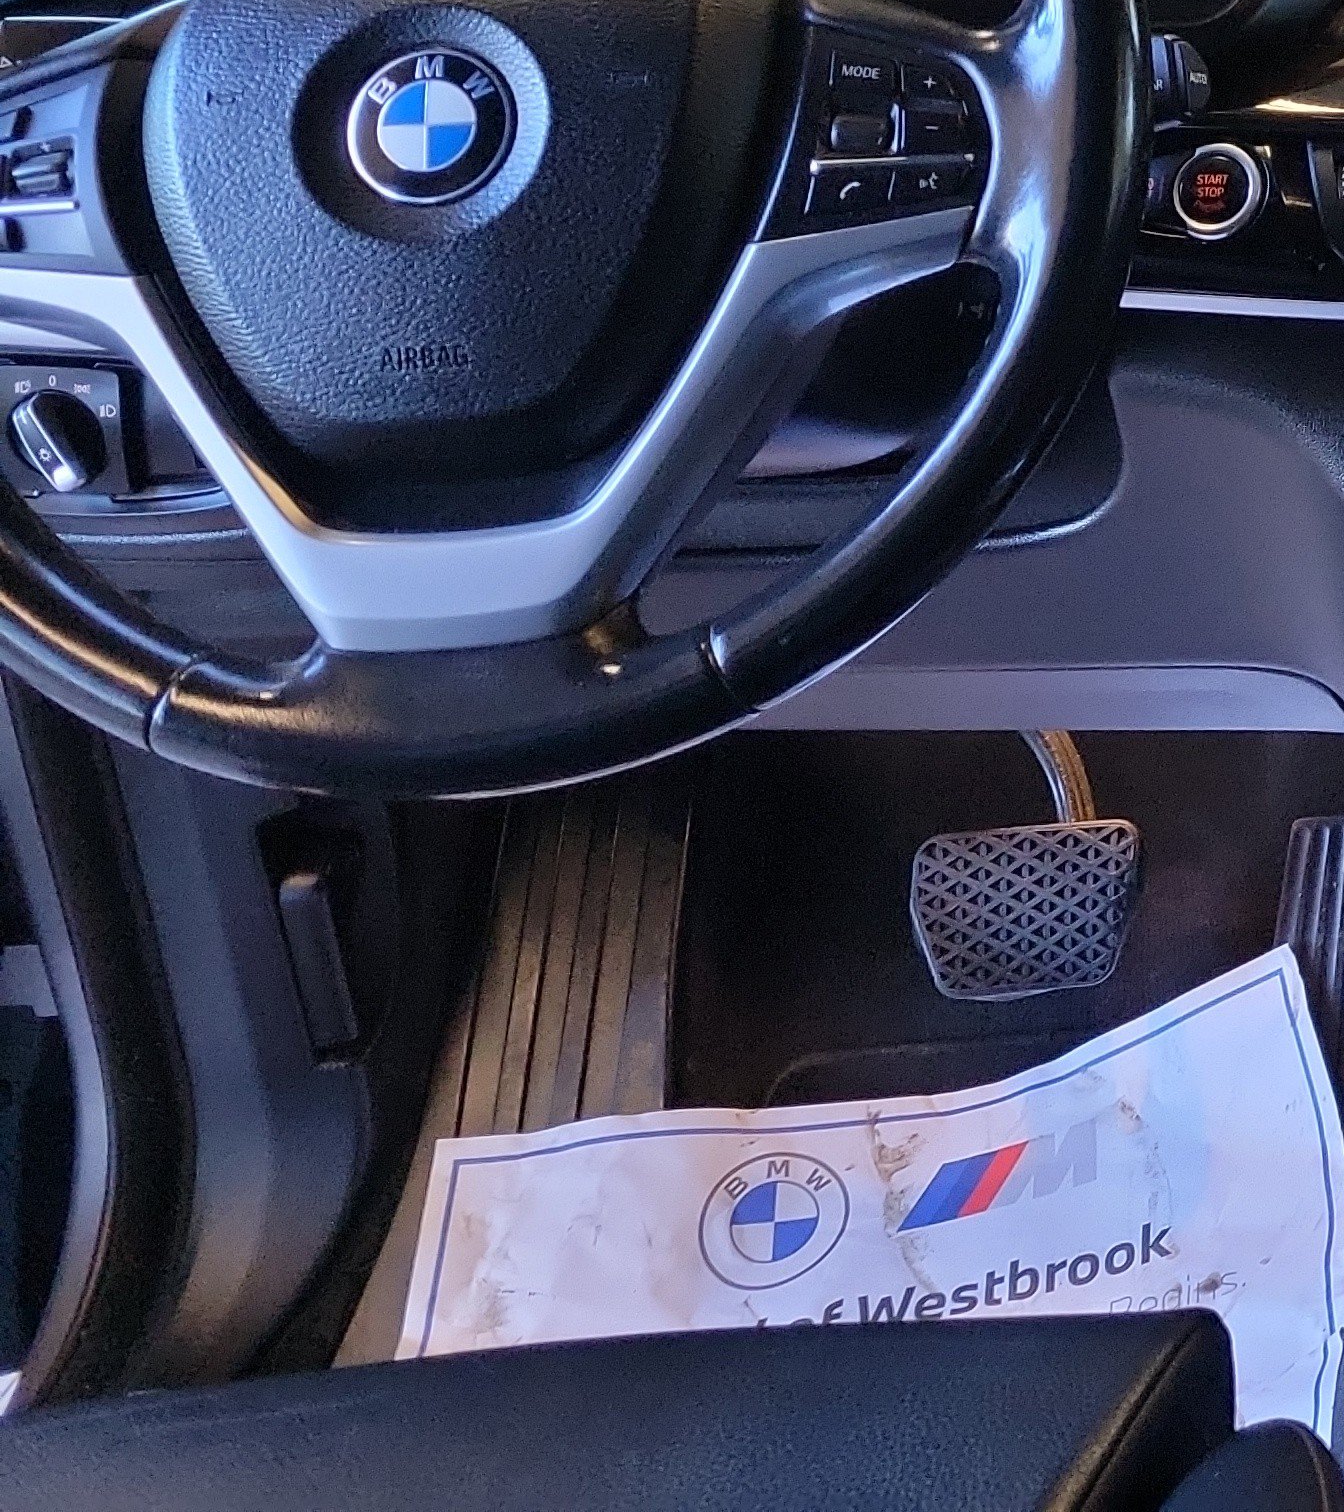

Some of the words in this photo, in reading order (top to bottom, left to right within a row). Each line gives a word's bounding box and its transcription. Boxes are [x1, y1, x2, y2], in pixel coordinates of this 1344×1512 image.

[367, 54, 496, 105] BMW
[842, 64, 881, 80] MODE
[1196, 174, 1229, 185] START
[1197, 186, 1225, 198] STOP
[380, 346, 469, 372] AIRBAG
[723, 1159, 833, 1200] BMW
[858, 1221, 1173, 1324] Westbrook
